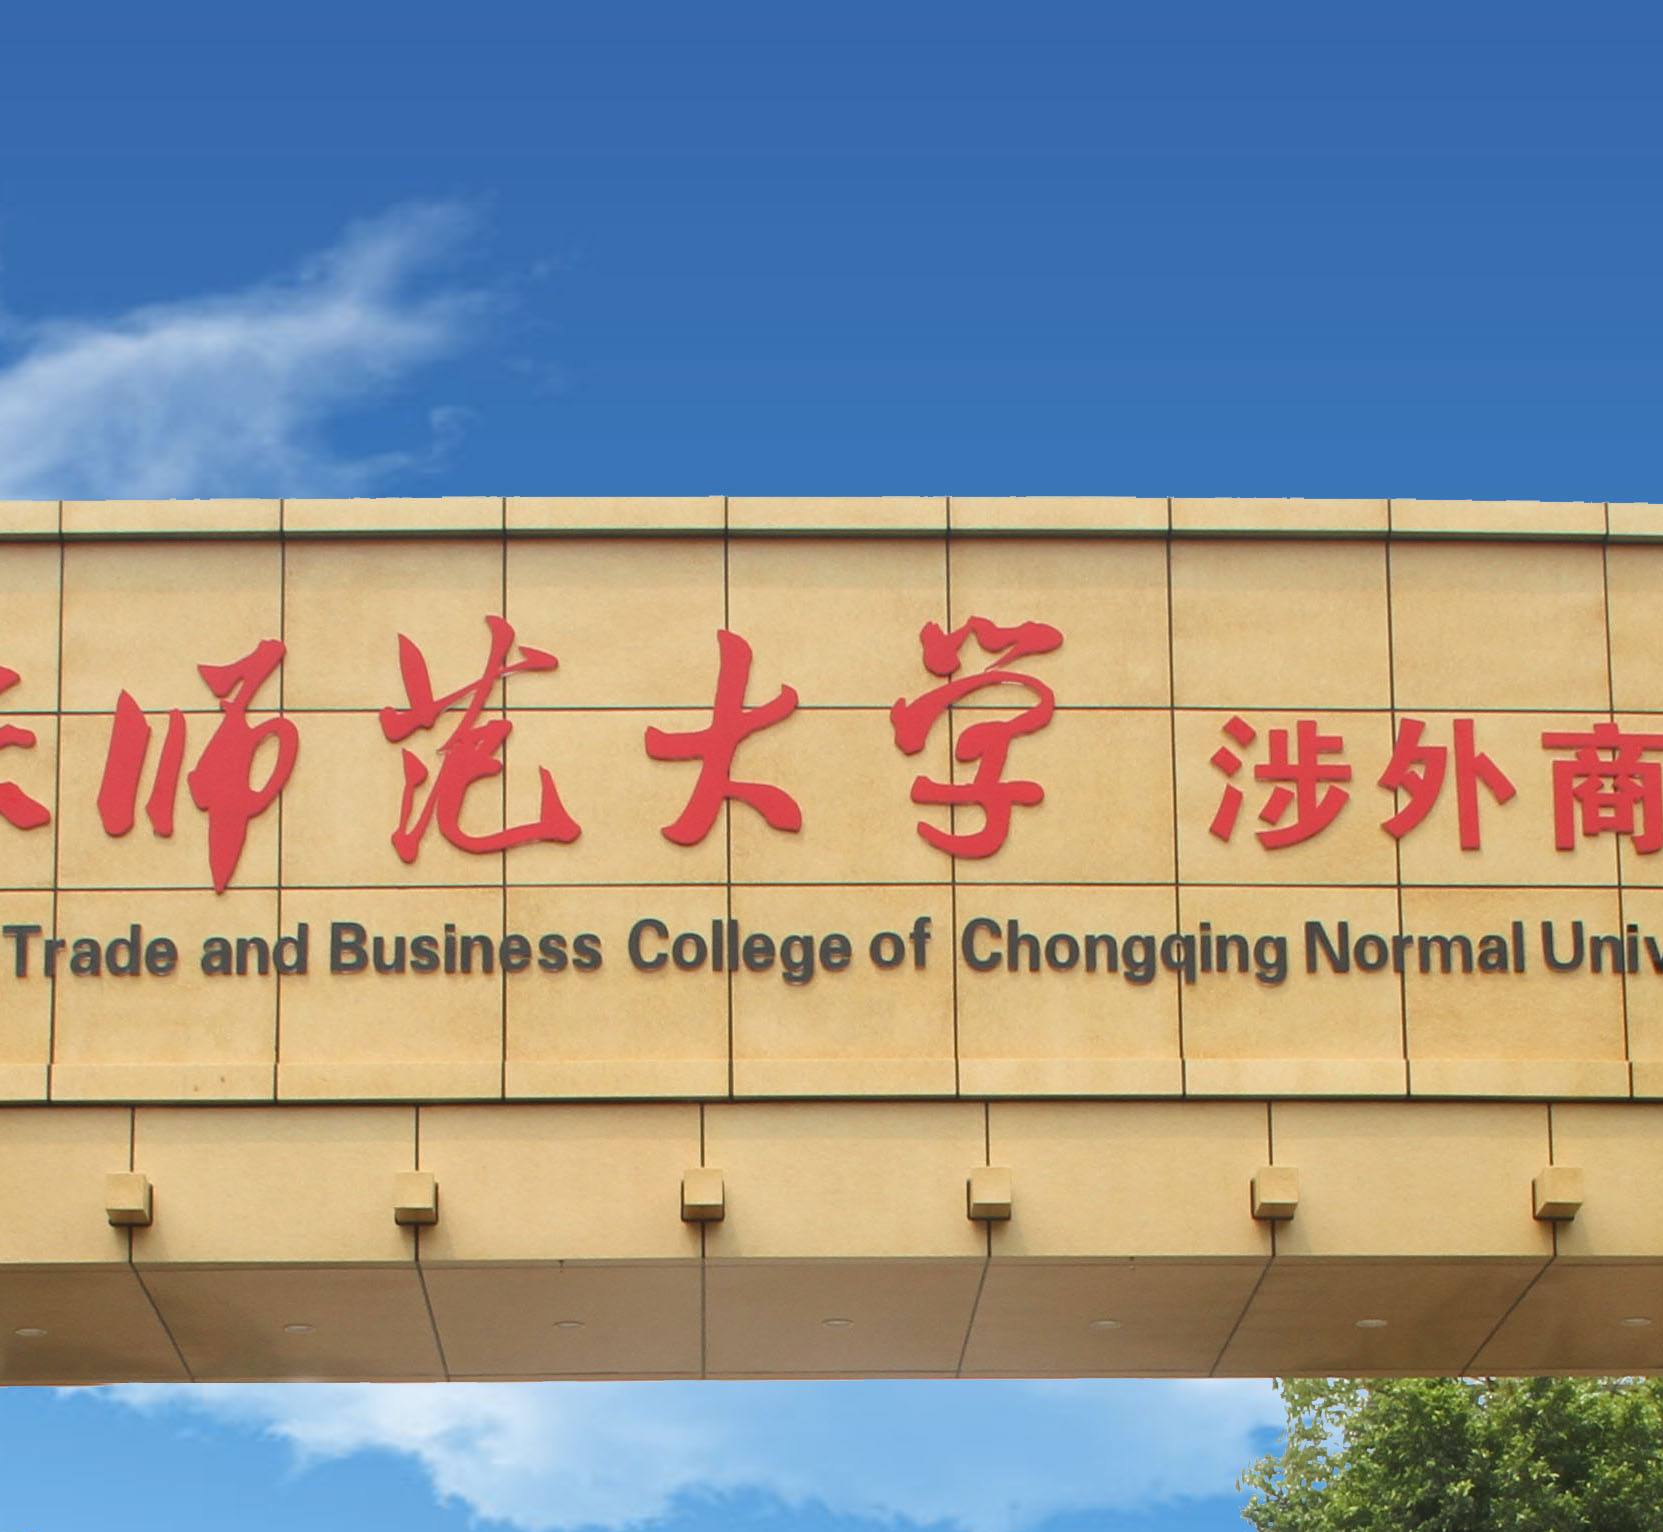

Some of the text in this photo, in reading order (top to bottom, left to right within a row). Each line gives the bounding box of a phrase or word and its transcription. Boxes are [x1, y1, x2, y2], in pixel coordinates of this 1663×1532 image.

[2, 923, 178, 979] Trade
[199, 921, 310, 976] and
[329, 919, 604, 974] Business
[627, 917, 854, 985] College
[869, 915, 933, 971] of
[962, 916, 1290, 986] Chongqing
[1305, 920, 1528, 975] Normal
